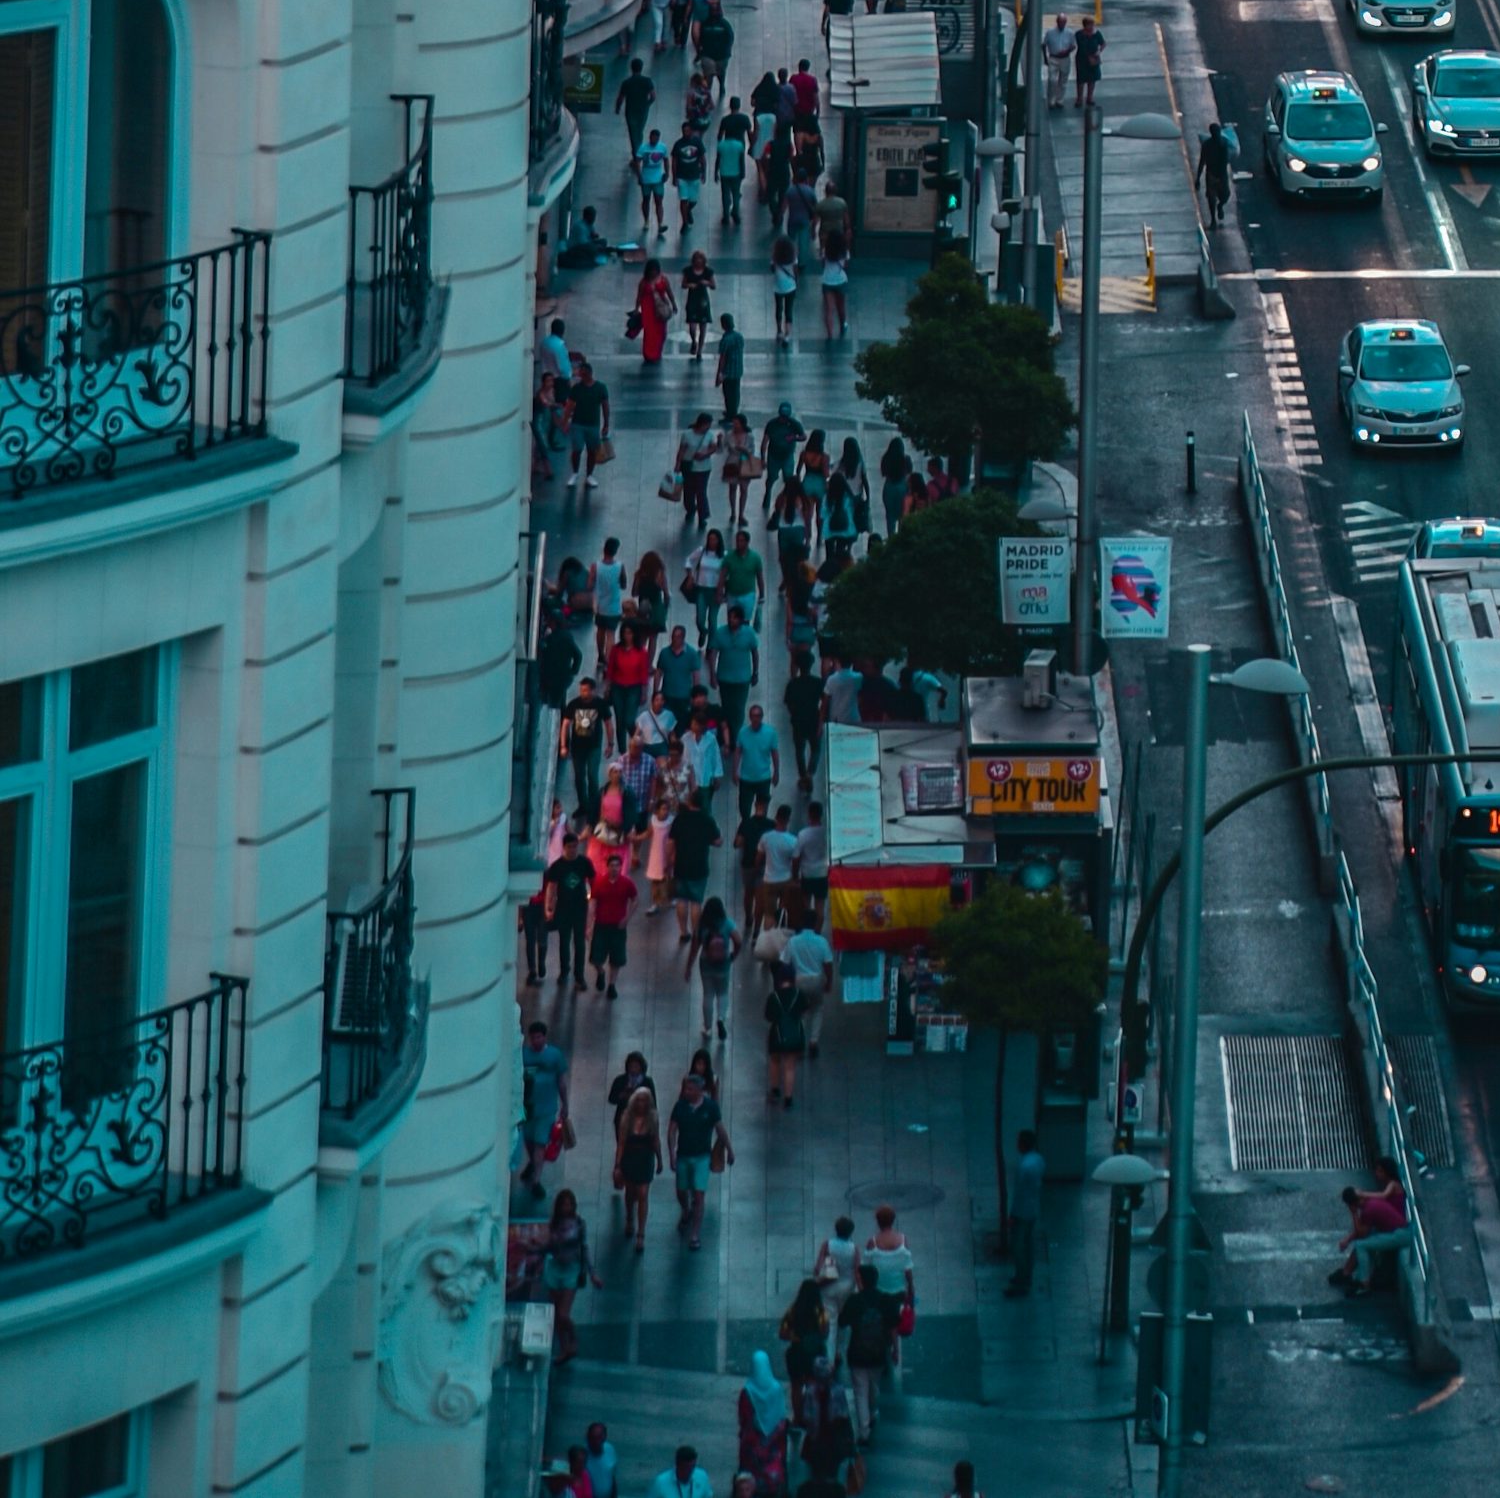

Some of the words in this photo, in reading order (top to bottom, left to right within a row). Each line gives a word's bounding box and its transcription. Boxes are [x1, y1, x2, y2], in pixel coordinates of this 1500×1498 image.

[1006, 545, 1064, 557] MADRID
[1006, 559, 1049, 570] PRIDE
[989, 778, 1031, 802] CITY
[1037, 778, 1086, 802] TOUR
